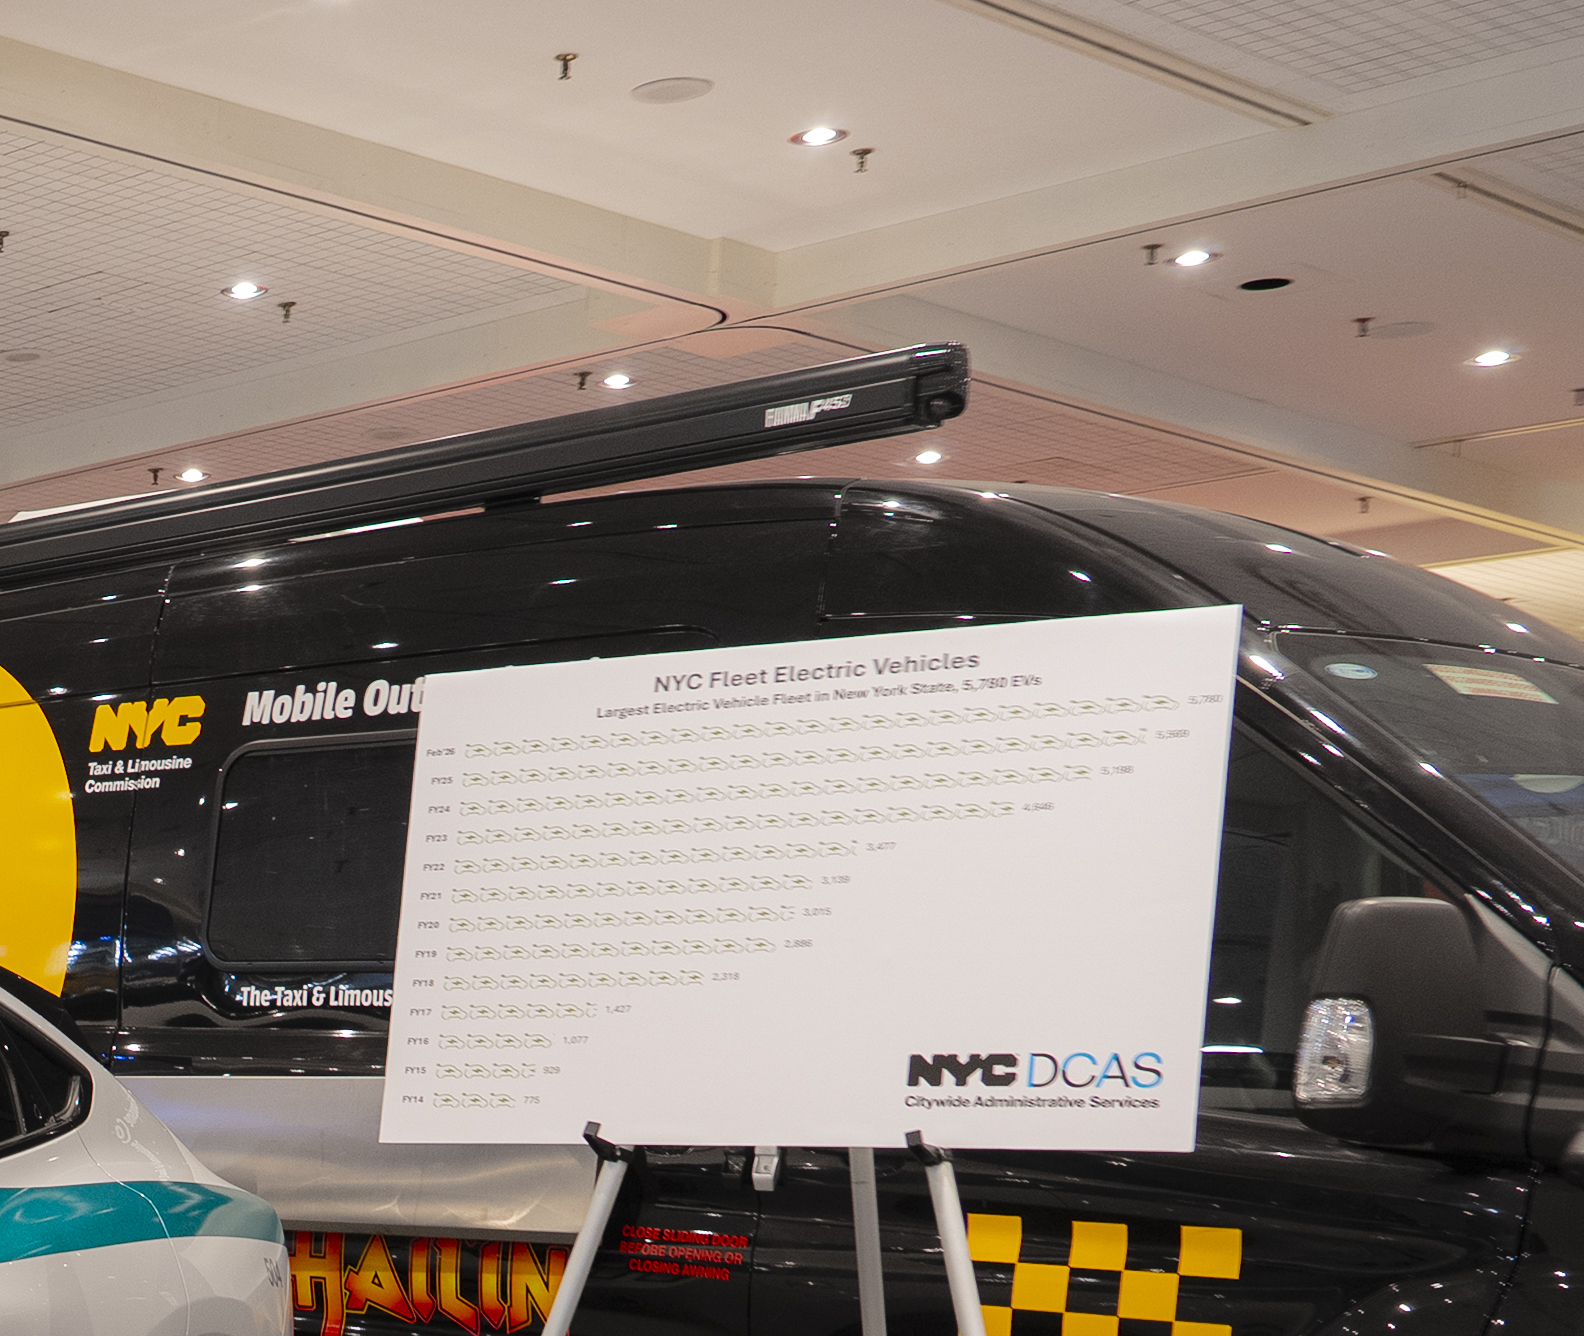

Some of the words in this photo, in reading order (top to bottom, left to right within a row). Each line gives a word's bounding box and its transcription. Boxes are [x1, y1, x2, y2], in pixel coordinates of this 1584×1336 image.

[653, 673, 703, 694] NYC
[708, 669, 767, 688] Fleet
[773, 660, 867, 685] Electric
[872, 652, 981, 676] Vehicles
[242, 681, 354, 727] Mobile
[362, 676, 426, 716] Out
[596, 704, 649, 719] Largest
[653, 699, 710, 714] Electric
[712, 695, 769, 711] Vehicle
[772, 691, 813, 706] Fleet
[815, 689, 830, 702] in
[833, 687, 869, 702] New
[872, 684, 908, 699] York
[1010, 674, 1043, 688] EVs
[88, 694, 207, 753] NYC
[88, 761, 112, 776] Taxi
[114, 760, 124, 774] &
[127, 755, 193, 774] Limousine
[84, 775, 161, 794] Commission
[429, 804, 451, 815] FY24
[426, 833, 448, 843] FY23
[423, 862, 445, 872] FY22
[420, 892, 442, 900] FY21
[417, 921, 440, 929] FY20
[415, 950, 437, 958] FY19
[412, 979, 434, 987] FY18
[241, 986, 271, 1008] The
[273, 985, 308, 1007] Taxi
[312, 986, 325, 1007] &
[410, 1008, 432, 1016] FY17
[605, 1004, 632, 1015] 1,427
[407, 1037, 429, 1046] FY16
[404, 1066, 427, 1075] FY15
[907, 1053, 1019, 1087] NYC
[1027, 1052, 1163, 1088] DCAS
[402, 1095, 424, 1104] FY14
[905, 1095, 971, 1110] Citywide
[973, 1095, 1086, 1109] Administrative
[1089, 1095, 1161, 1109] Services
[622, 1225, 661, 1240] CLOSE
[662, 1229, 709, 1245] SLIDING
[712, 1233, 749, 1249] DOOR
[619, 1241, 666, 1257] BEFORE
[668, 1246, 722, 1263] OPENING
[724, 1251, 743, 1265] OR
[629, 1258, 680, 1275] CLOSING
[681, 1264, 730, 1281] AWNING
